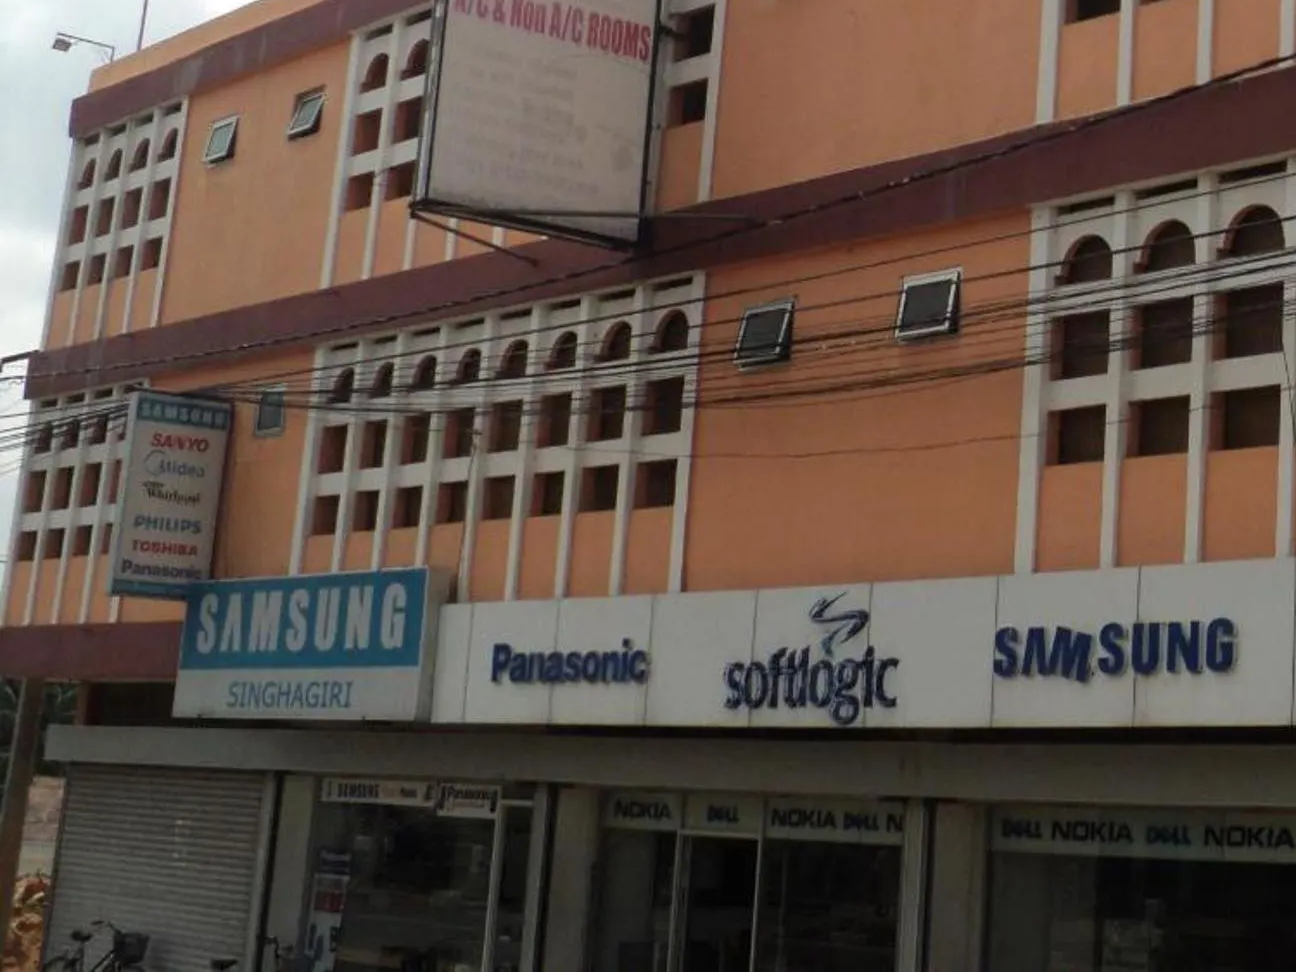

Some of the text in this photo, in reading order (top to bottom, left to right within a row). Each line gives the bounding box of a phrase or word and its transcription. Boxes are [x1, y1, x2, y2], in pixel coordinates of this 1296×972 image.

[549, 1, 583, 44] A/C
[587, 12, 652, 62] ROOMS
[140, 402, 226, 426] SAMSUNG
[151, 432, 209, 452] SANYO
[133, 514, 202, 533] PHILIPS
[132, 539, 198, 556] TOSHIBA
[121, 558, 202, 579] Panasonic
[197, 583, 407, 654] SAMSUNG
[491, 638, 649, 683] Panasonic
[993, 618, 1236, 684] SAMSUNG
[226, 680, 354, 709] SINGHAGIRI
[722, 645, 900, 726] softlogic
[614, 800, 672, 819] NOKIA
[707, 805, 739, 823] DELL
[771, 808, 836, 828] NOKIA
[843, 811, 878, 830] DELL
[1002, 817, 1042, 839] DELL
[1051, 820, 1133, 844] NOKIA
[1145, 824, 1192, 846] DELL
[1203, 824, 1296, 849] NOKIA
